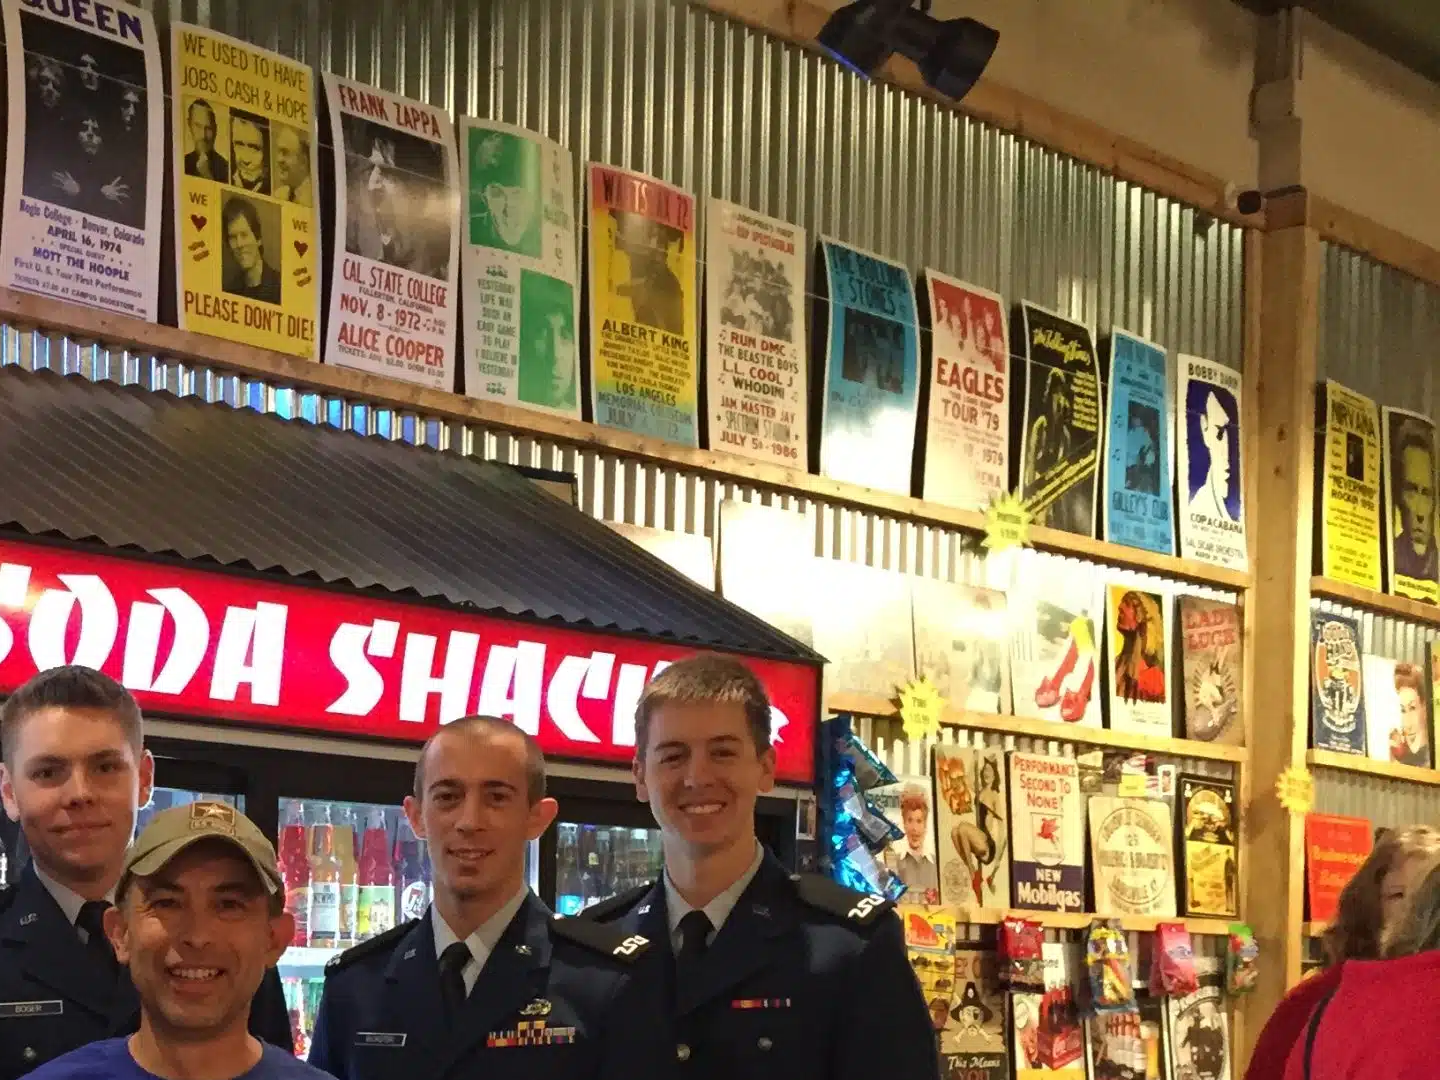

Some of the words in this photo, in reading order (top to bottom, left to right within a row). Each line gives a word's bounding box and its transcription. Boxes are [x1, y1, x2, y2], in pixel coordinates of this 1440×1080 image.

[26, 0, 143, 44] UEEN
[183, 31, 206, 57] WE
[212, 40, 248, 71] USED
[253, 54, 270, 79] TO
[274, 62, 306, 92] HAVE
[225, 78, 259, 106] CASH
[263, 89, 273, 111] &
[276, 94, 309, 124] HOPE
[337, 84, 388, 122] FRANK
[394, 102, 442, 139] ZAPPA
[189, 191, 208, 206] WE
[47, 225, 77, 242] APRIL
[100, 239, 122, 254] 1974
[292, 218, 308, 233] WE
[33, 247, 61, 263] MOTT
[66, 255, 84, 270] THE
[89, 262, 129, 281] HOOPLE
[343, 258, 365, 284] CAL.
[369, 266, 404, 295] STATE
[407, 278, 447, 308] COLLEGE
[184, 291, 239, 324] PLEASE
[244, 303, 284, 334] DON'T
[287, 313, 314, 342] DIE!
[340, 293, 371, 318] NOV.
[377, 303, 385, 321] 8
[395, 309, 421, 331] 1972
[338, 321, 381, 352] ALICE
[386, 334, 444, 368] COOPER
[602, 319, 657, 343] ALBERT
[662, 335, 689, 353] KING
[730, 332, 756, 349] RUN
[761, 340, 786, 357] DMC
[718, 342, 735, 359] THE
[738, 348, 774, 368] BEASTIE
[777, 359, 799, 374] BOYS
[722, 359, 745, 376] L.L.
[749, 366, 782, 385] COOL
[787, 376, 793, 388] J
[732, 376, 785, 400] WHODINI
[937, 357, 1004, 403] EAGLES
[616, 382, 635, 397] LOS
[640, 386, 676, 407] ANGELES
[720, 395, 737, 410] JAM
[741, 400, 776, 418] MASTER
[780, 410, 796, 424] JAY
[942, 399, 978, 425] TOUR
[981, 411, 1000, 431] '79
[720, 430, 746, 447] JULY
[771, 442, 798, 459] 1986
[982, 449, 1004, 466] 1979
[1013, 755, 1077, 777] PERFORMANCE
[1035, 869, 1063, 883] NEW
[1018, 882, 1081, 912] Mobilgas
[948, 1056, 968, 1070] This
[970, 1056, 1000, 1068] Means
